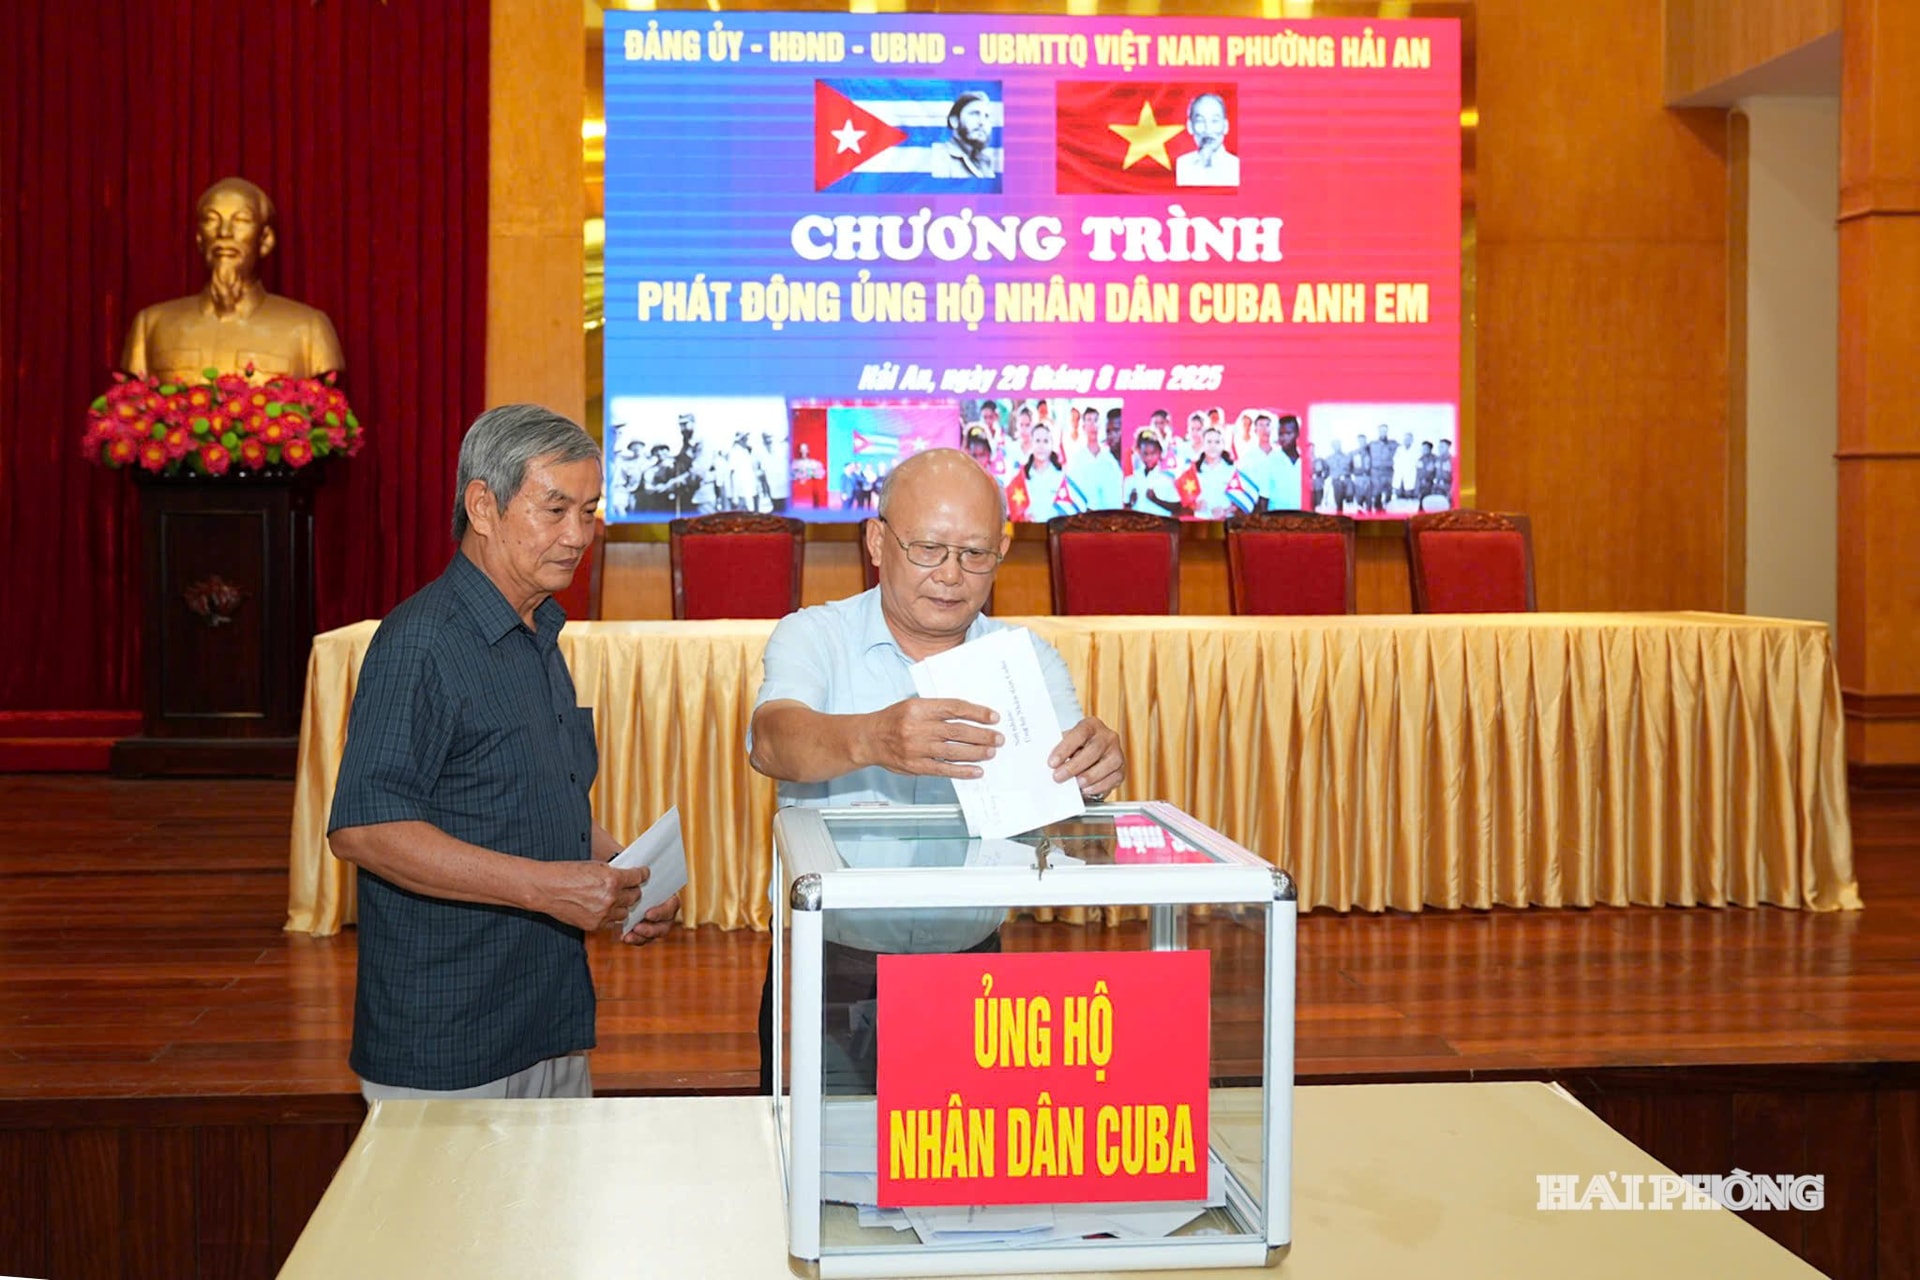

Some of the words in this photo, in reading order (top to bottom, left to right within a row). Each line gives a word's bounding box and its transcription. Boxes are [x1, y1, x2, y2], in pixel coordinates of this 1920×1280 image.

[624, 20, 701, 61] ĐẢNG
[708, 20, 743, 61] ỦY
[751, 45, 763, 54] -
[770, 31, 845, 62] HĐND
[852, 45, 864, 54] -
[871, 32, 946, 64] UBND
[952, 46, 965, 55] -
[979, 33, 1088, 68] UBMTTQ
[1093, 29, 1151, 72] VIỆT
[1158, 35, 1220, 67] NAM
[1227, 29, 1335, 68] PHƯỜNG
[1341, 27, 1386, 68] HẢI
[1393, 37, 1430, 69] AN
[791, 207, 1066, 262] CHƯƠNG
[1081, 204, 1283, 263] TRÌNH
[638, 273, 732, 323] PHÁT
[740, 273, 840, 331] ĐỘNG
[851, 269, 927, 323] ỦNG
[936, 274, 985, 331] HỘ
[995, 275, 1095, 323] NHÂN
[1105, 275, 1179, 323] DÂN
[1189, 282, 1284, 323] CUBA
[1292, 282, 1366, 323] ANH
[1375, 283, 1429, 323] EM
[1166, 365, 1224, 391] 2025
[974, 973, 1051, 1068] ỦNG
[1063, 981, 1113, 1081] HỘ
[889, 1093, 995, 1180] NHÂN
[1006, 1092, 1084, 1178] DÂN
[1097, 1104, 1196, 1176] CUBA
